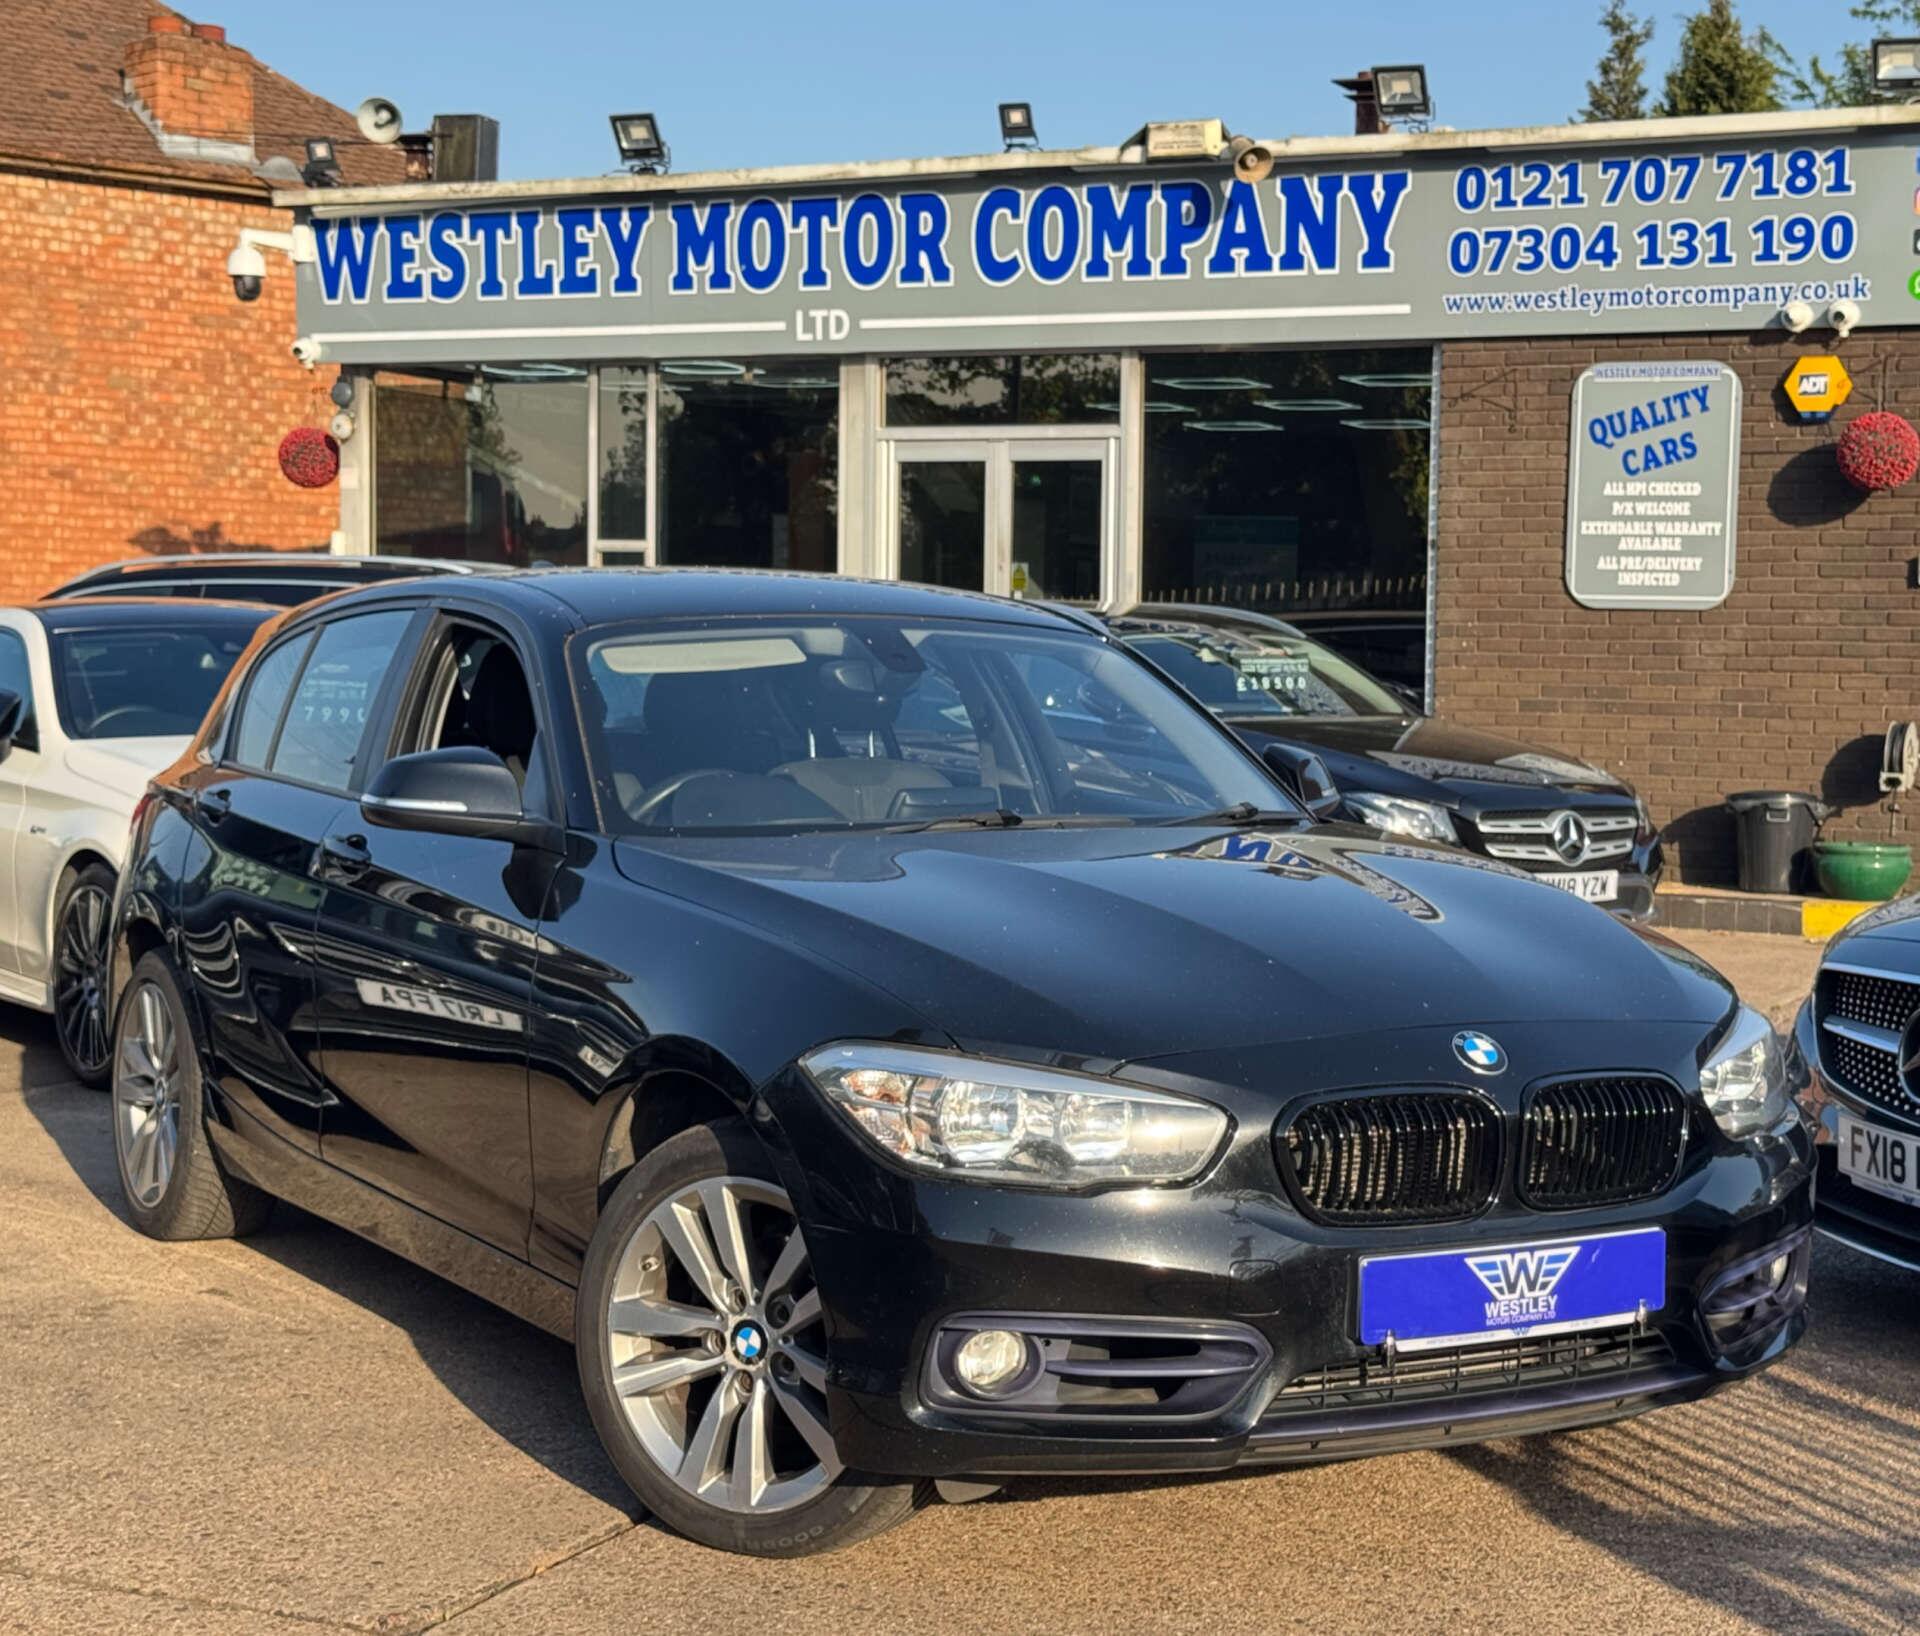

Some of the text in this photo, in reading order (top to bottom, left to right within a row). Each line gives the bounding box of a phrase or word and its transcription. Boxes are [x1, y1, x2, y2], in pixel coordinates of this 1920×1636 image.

[1454, 146, 1855, 213] 0121 707 7181
[309, 169, 1412, 304] WESTLEY MOTOR COMPANY
[1448, 211, 1857, 277] 07304 131 190
[1444, 273, 1870, 317] www.westleymotorcompany.co.uk
[795, 308, 850, 341] LTD
[1595, 366, 1720, 378] WESTLEY MOTOR COMPANY
[1799, 376, 1828, 394] ADT
[1588, 384, 1710, 449] QUALITY
[1622, 432, 1699, 477] CARS
[1603, 482, 1702, 496] ALL HPI CHECKED
[1612, 502, 1691, 516] P/X WELCOME
[1580, 521, 1722, 536] EXTENDABLE WARRANTY
[1618, 537, 1682, 551] AVAILABLE
[1597, 556, 1703, 571] ALL PRE/DELIVERY
[1617, 572, 1681, 586] INSPECTED
[1851, 1125, 1906, 1184] FX18
[1484, 1294, 1558, 1318] WESTLEY
[1486, 1310, 1557, 1326] MOTOR COMPANY LTD
